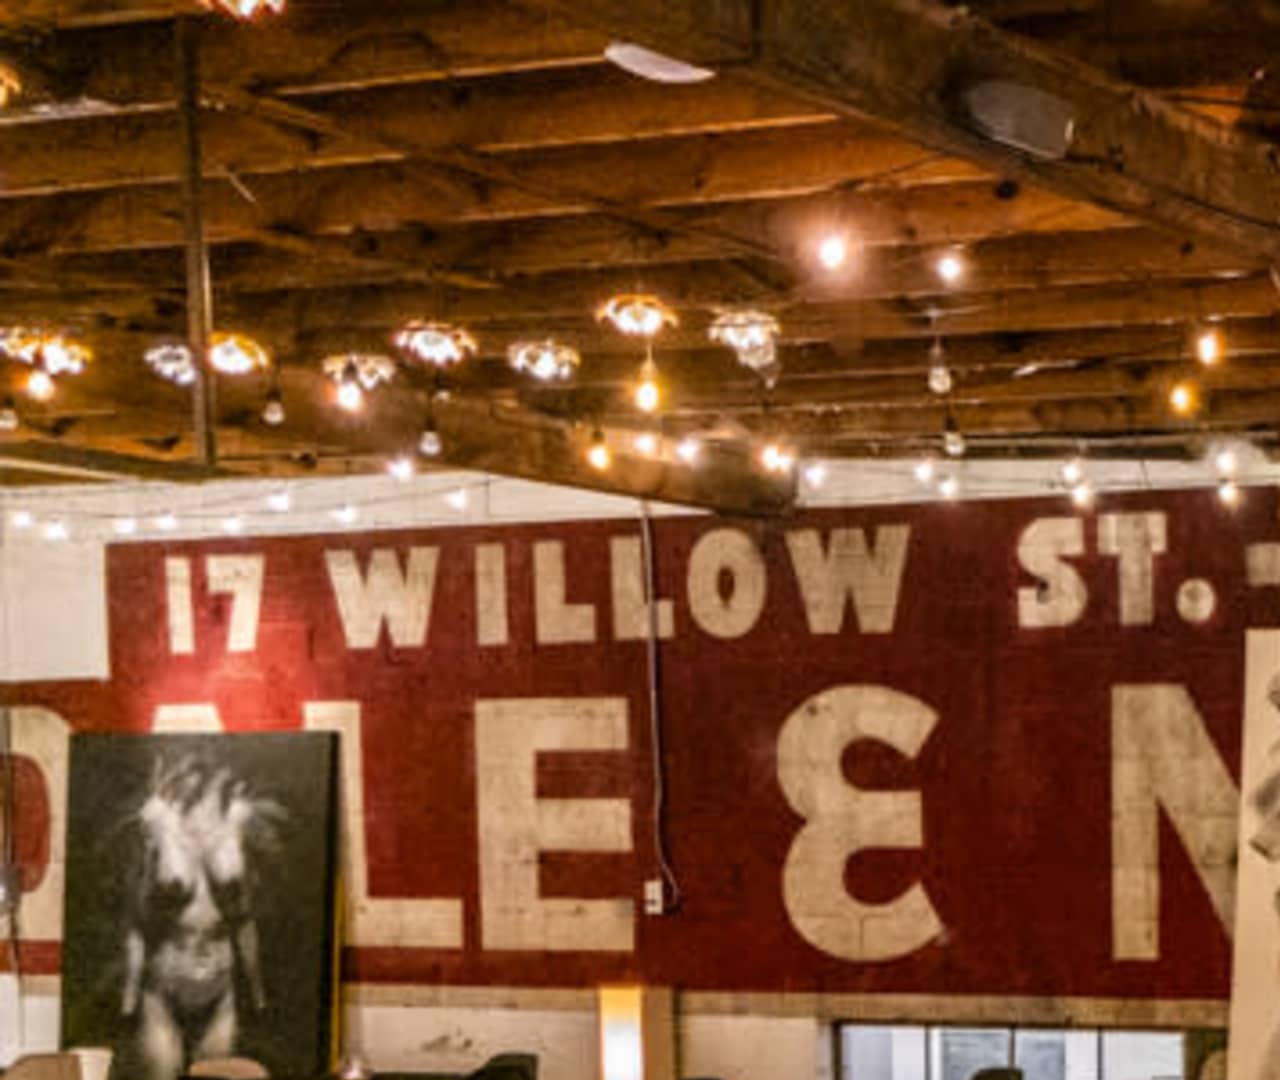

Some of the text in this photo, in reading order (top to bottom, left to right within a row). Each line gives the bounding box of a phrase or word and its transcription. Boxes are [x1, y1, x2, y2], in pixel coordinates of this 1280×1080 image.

[164, 554, 265, 655] 17
[324, 525, 911, 650] WILLOW
[1017, 511, 1217, 626] ST.
[0, 697, 637, 951] LE
